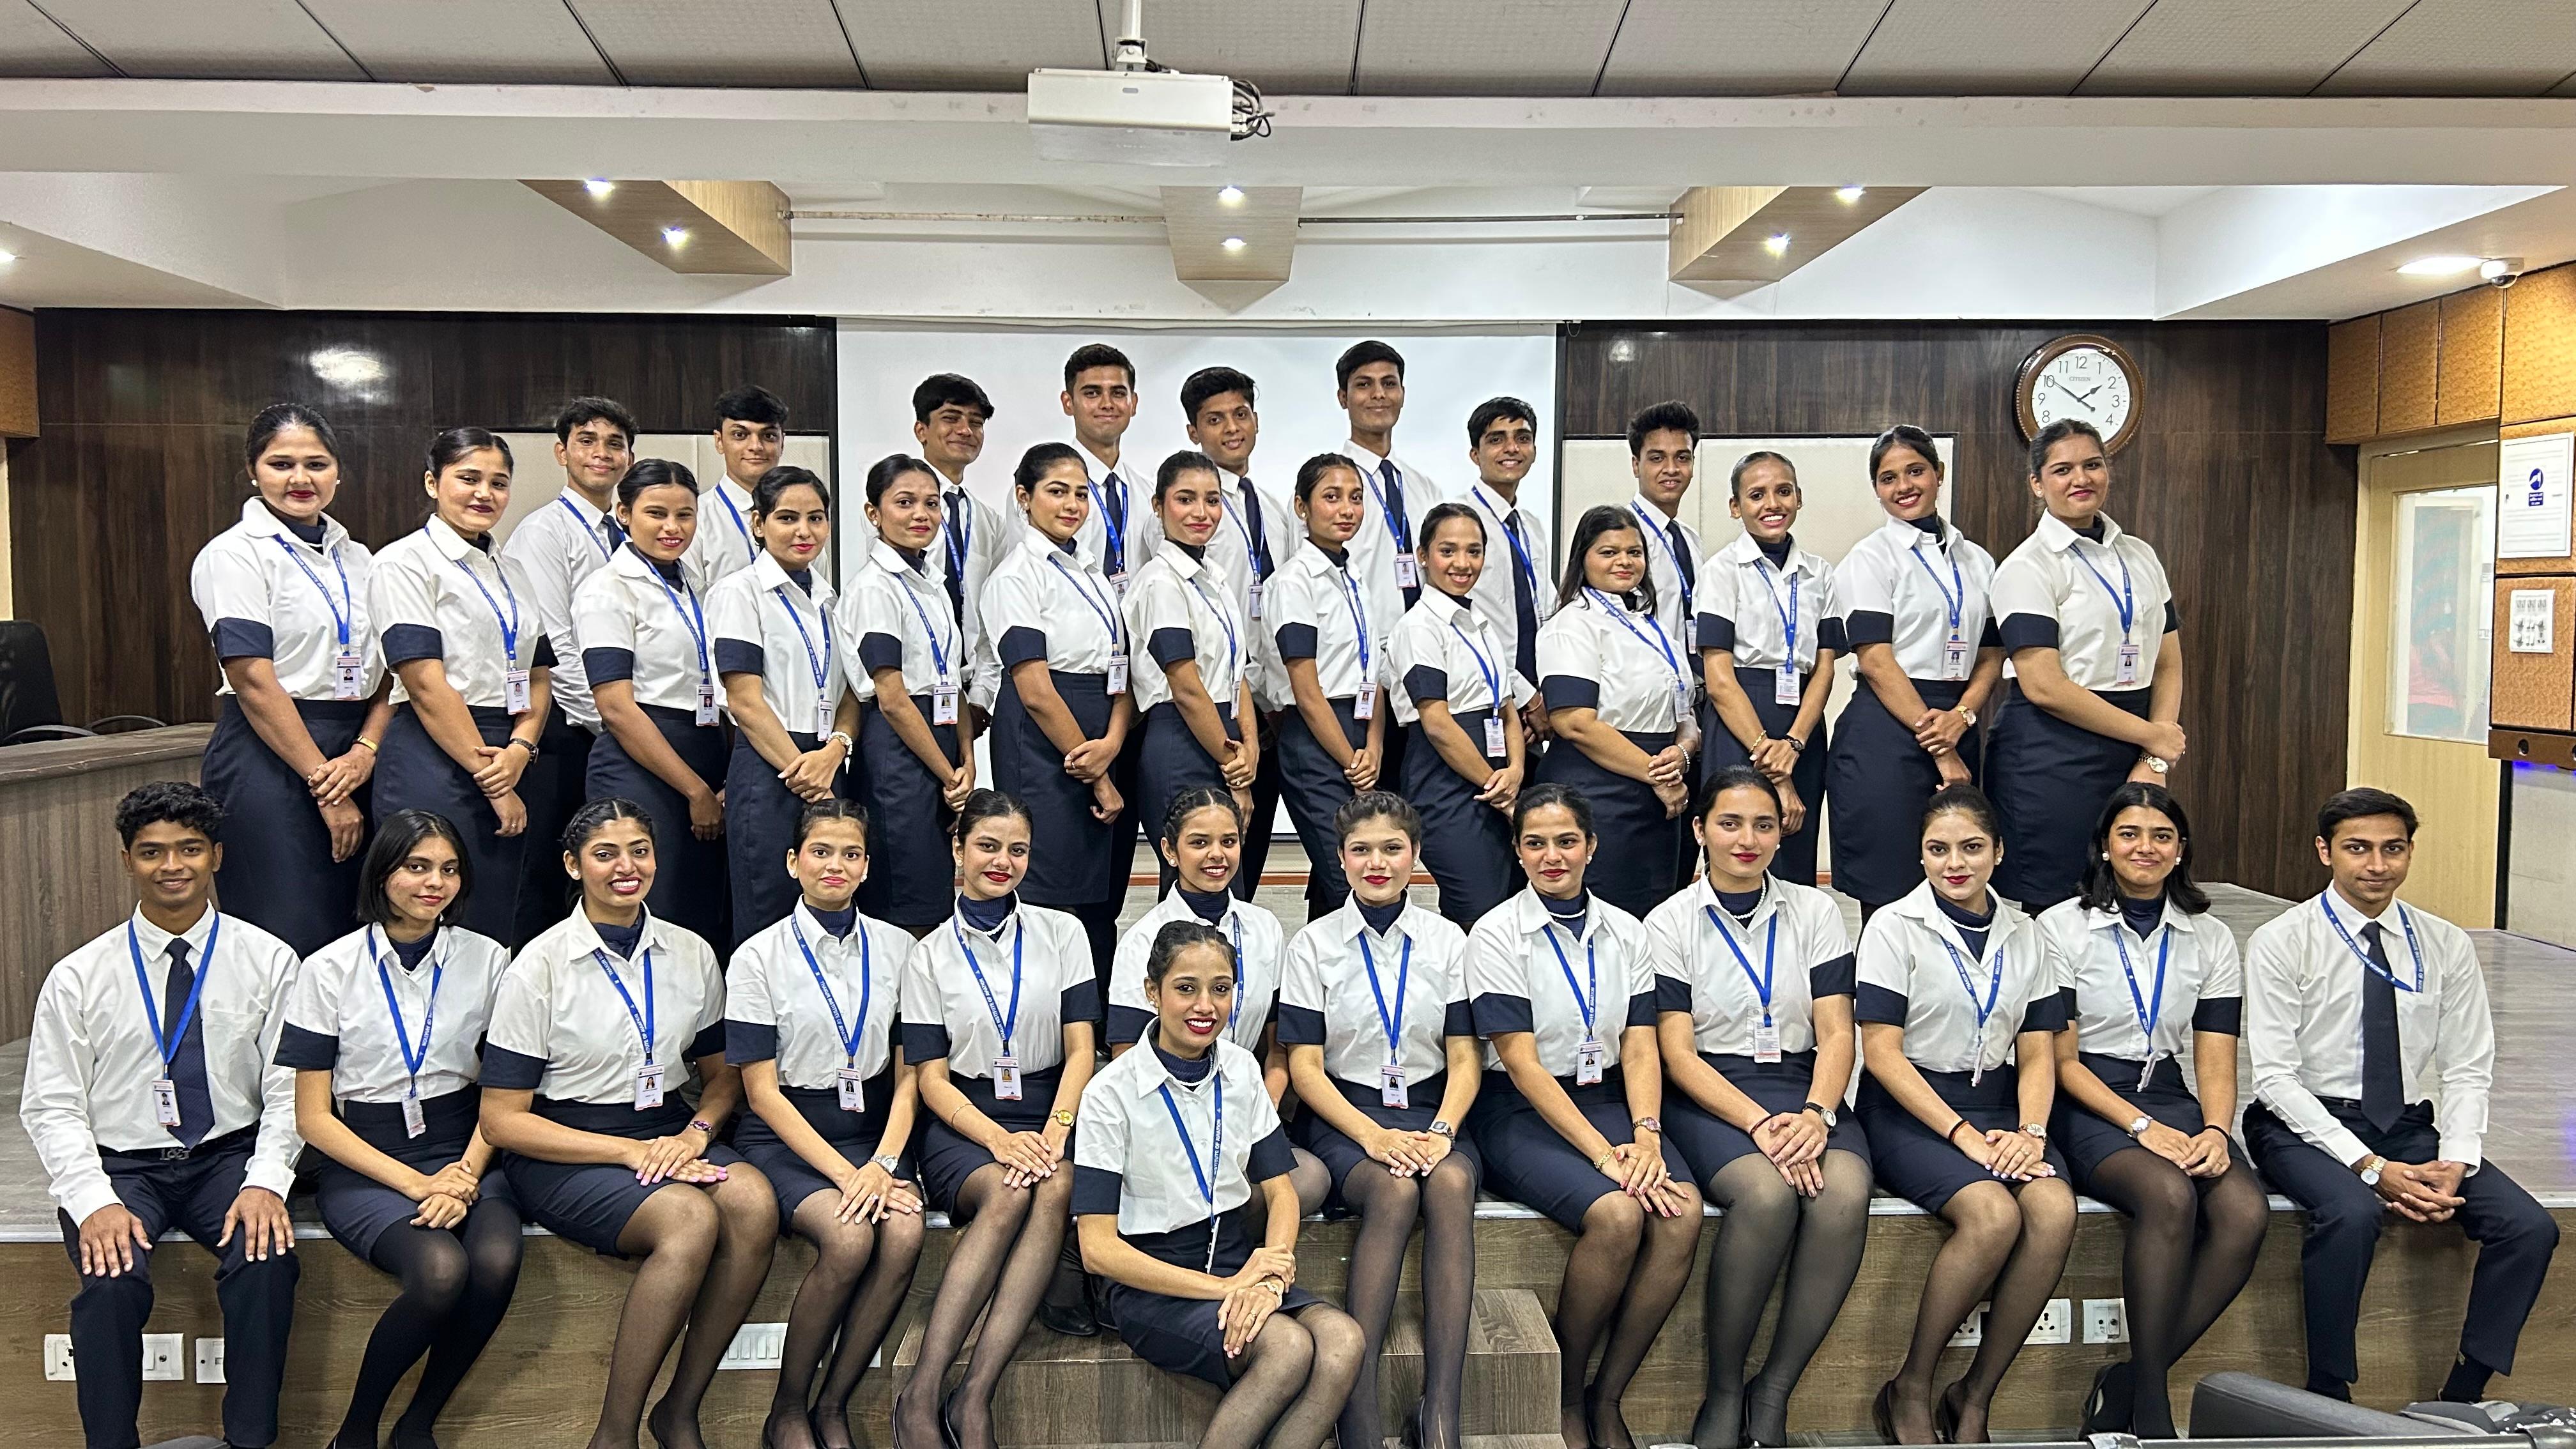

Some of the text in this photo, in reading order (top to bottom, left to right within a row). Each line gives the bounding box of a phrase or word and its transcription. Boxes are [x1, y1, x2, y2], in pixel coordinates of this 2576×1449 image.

[2058, 360, 2069, 374] 11
[2075, 356, 2087, 369] 12
[2097, 362, 2101, 374] 1
[2043, 375, 2055, 388] 10
[2108, 376, 2116, 389] 2
[2038, 392, 2046, 405] 9
[2112, 395, 2120, 408] 3
[2042, 410, 2050, 423] 8
[2105, 413, 2113, 425] 4
